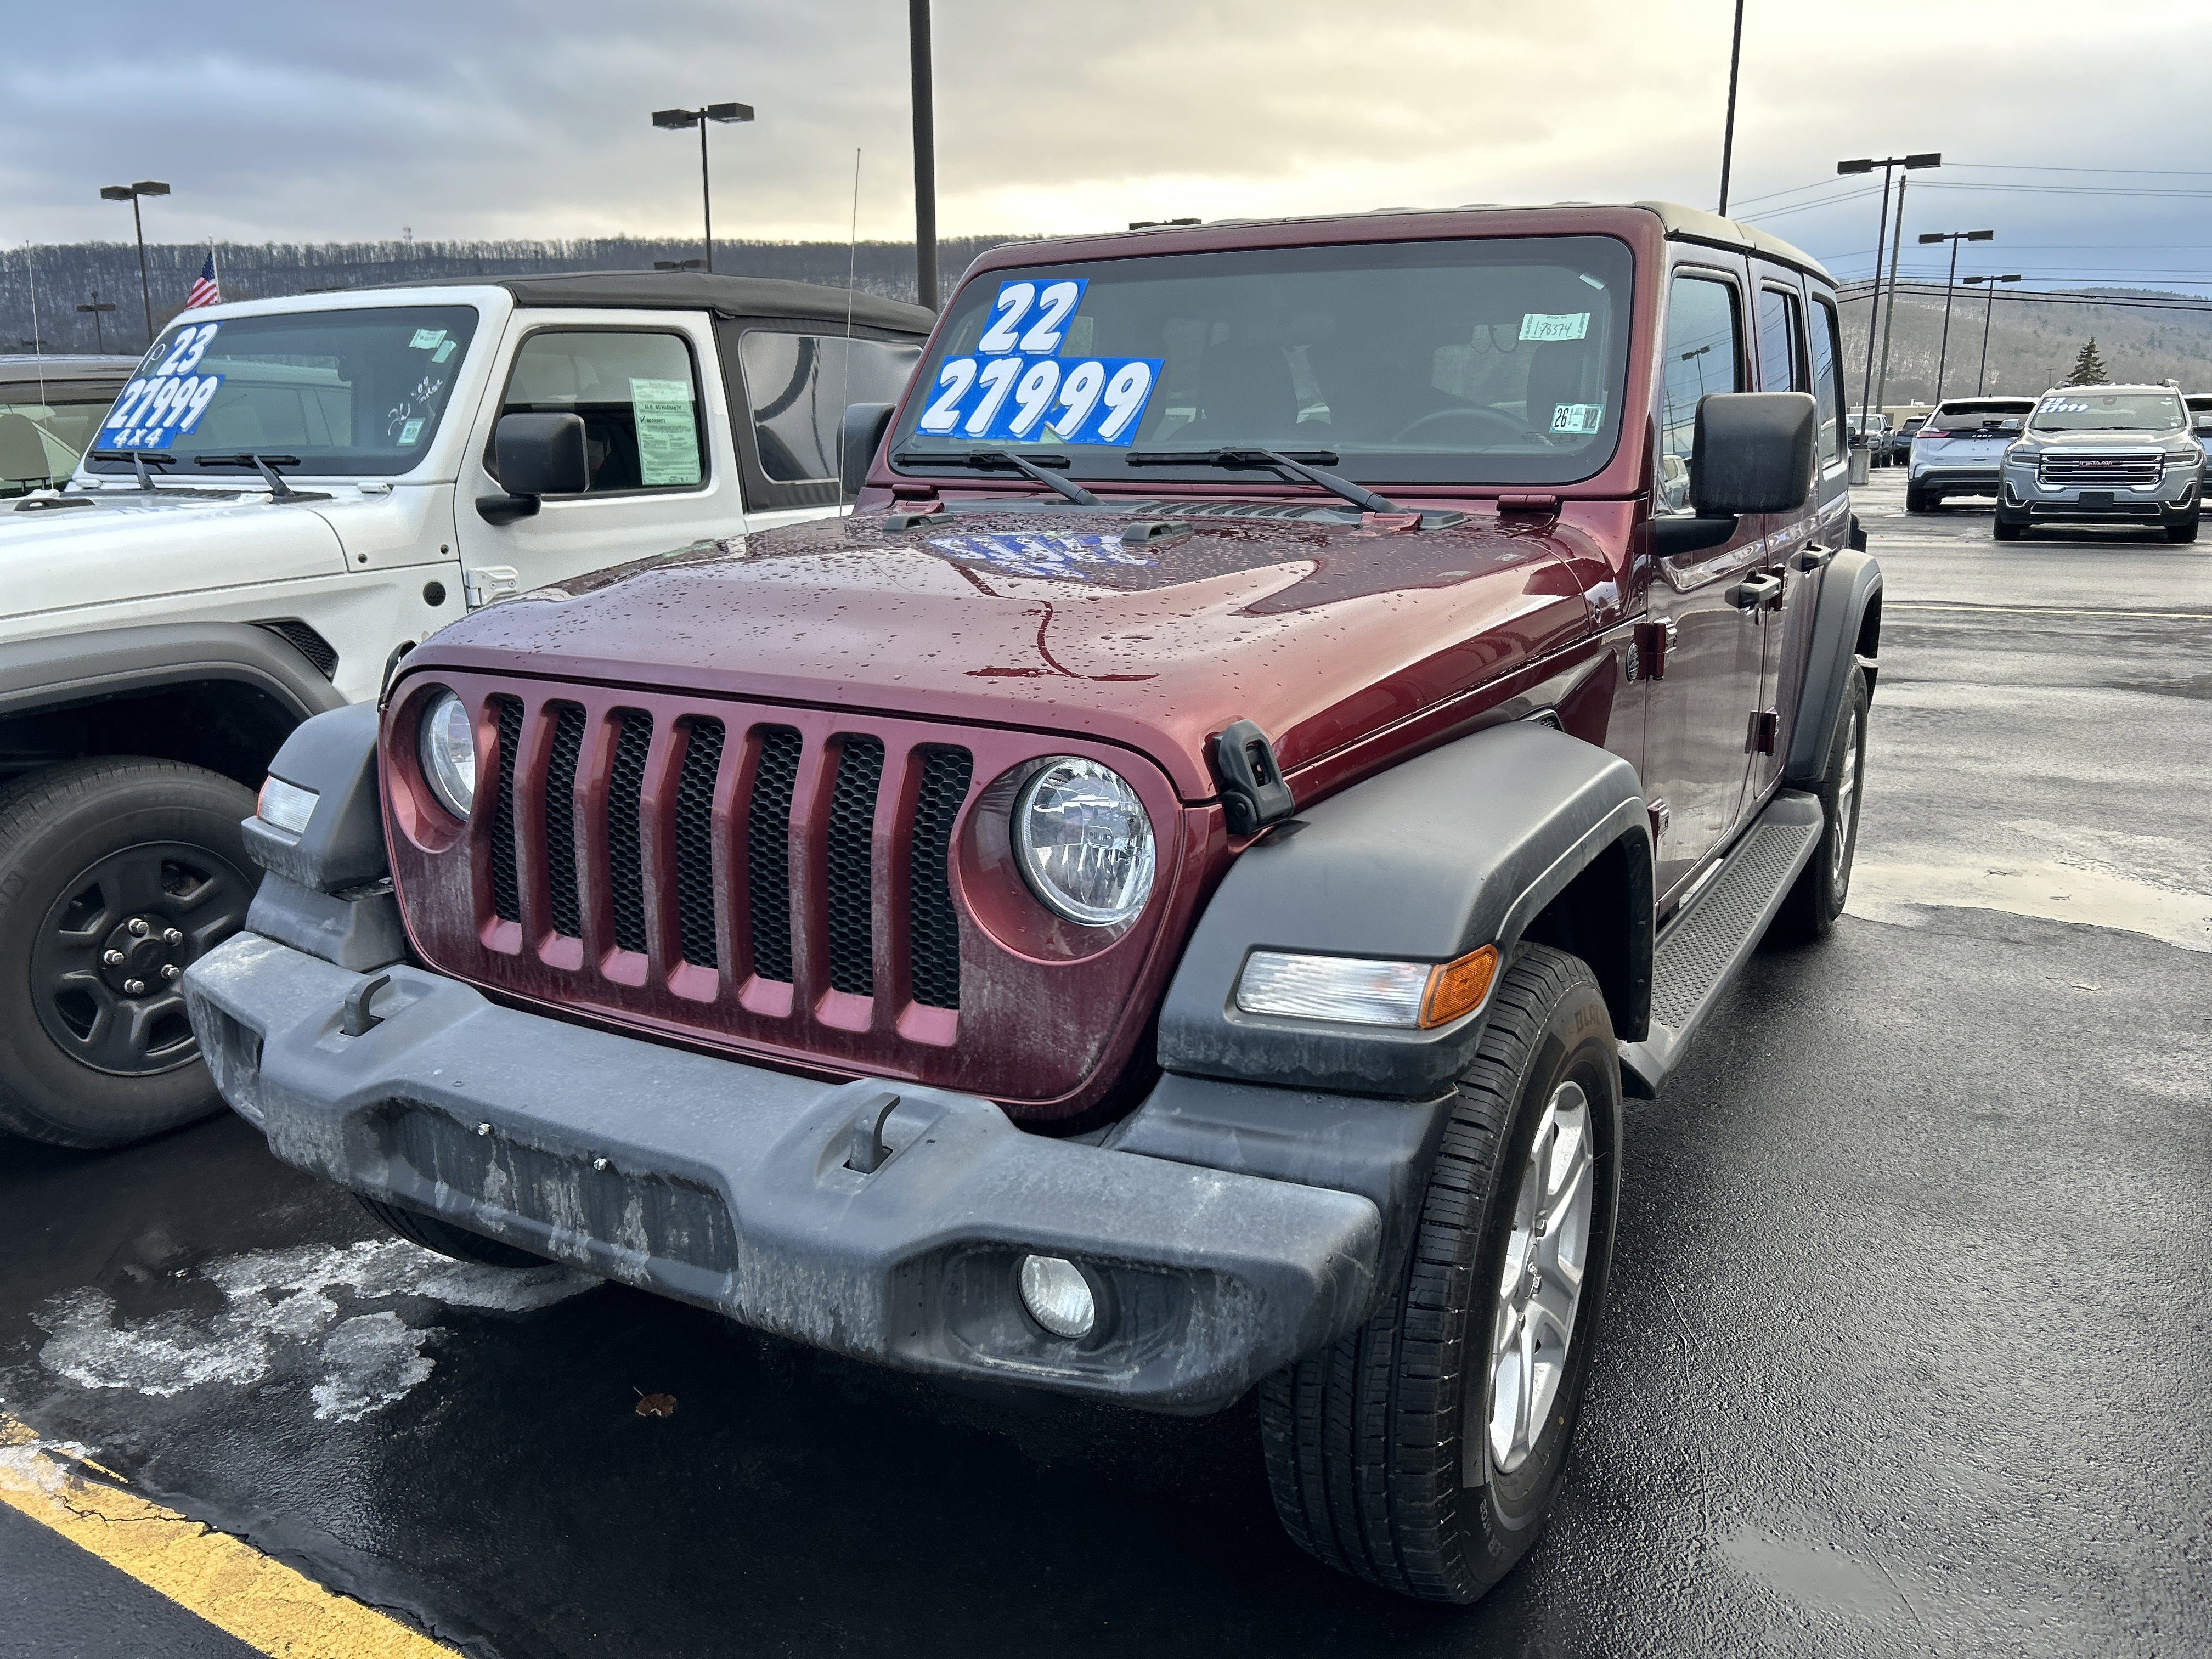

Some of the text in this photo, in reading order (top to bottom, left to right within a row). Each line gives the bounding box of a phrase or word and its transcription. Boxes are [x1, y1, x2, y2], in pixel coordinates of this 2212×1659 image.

[979, 282, 1079, 355] 22
[156, 323, 218, 376] 23
[106, 376, 218, 432] 27999
[921, 357, 1153, 442] 27999
[1554, 408, 1569, 427] 26
[2037, 404, 2089, 414] 27999
[2044, 397, 2067, 405] 23
[1584, 409, 1599, 429] 12
